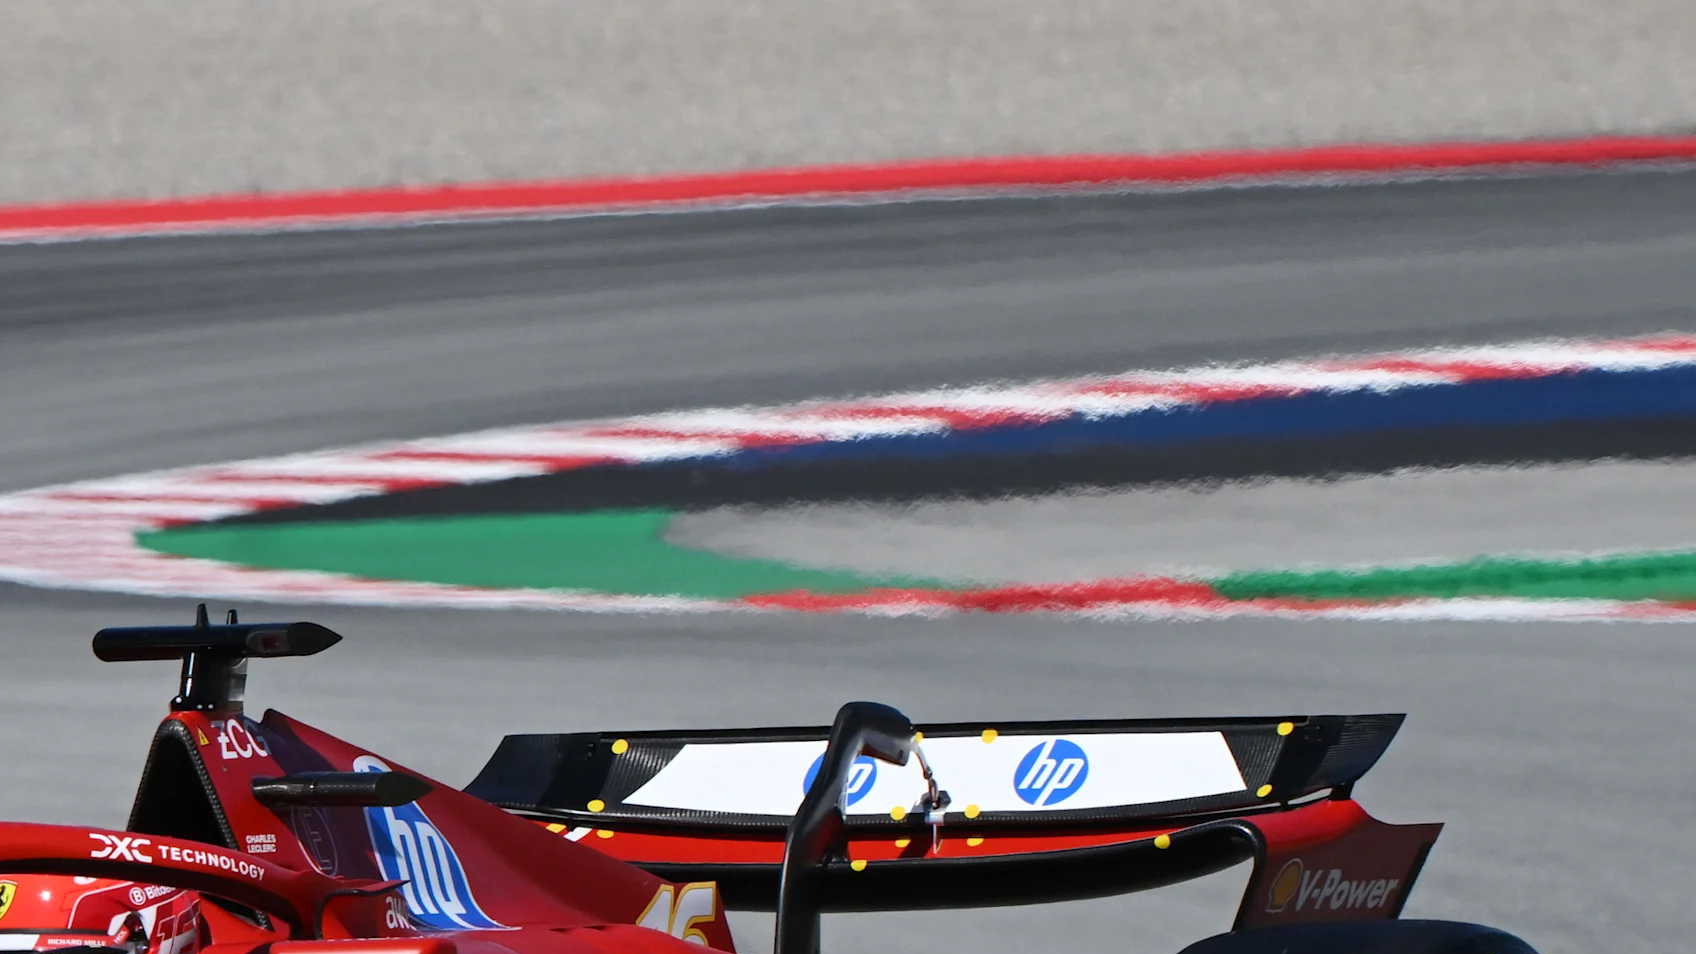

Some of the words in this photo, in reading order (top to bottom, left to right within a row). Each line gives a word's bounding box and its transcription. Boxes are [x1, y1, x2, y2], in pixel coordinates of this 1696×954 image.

[1018, 738, 1087, 807] hp
[88, 832, 153, 863] DXC
[157, 844, 266, 882] TECHNOLOGY
[245, 833, 277, 844] CHARLES
[246, 843, 277, 854] LECLERC
[1295, 868, 1400, 912] V-Power
[385, 896, 417, 931] aw
[635, 880, 717, 948] 16
[47, 938, 81, 946] RICHARD
